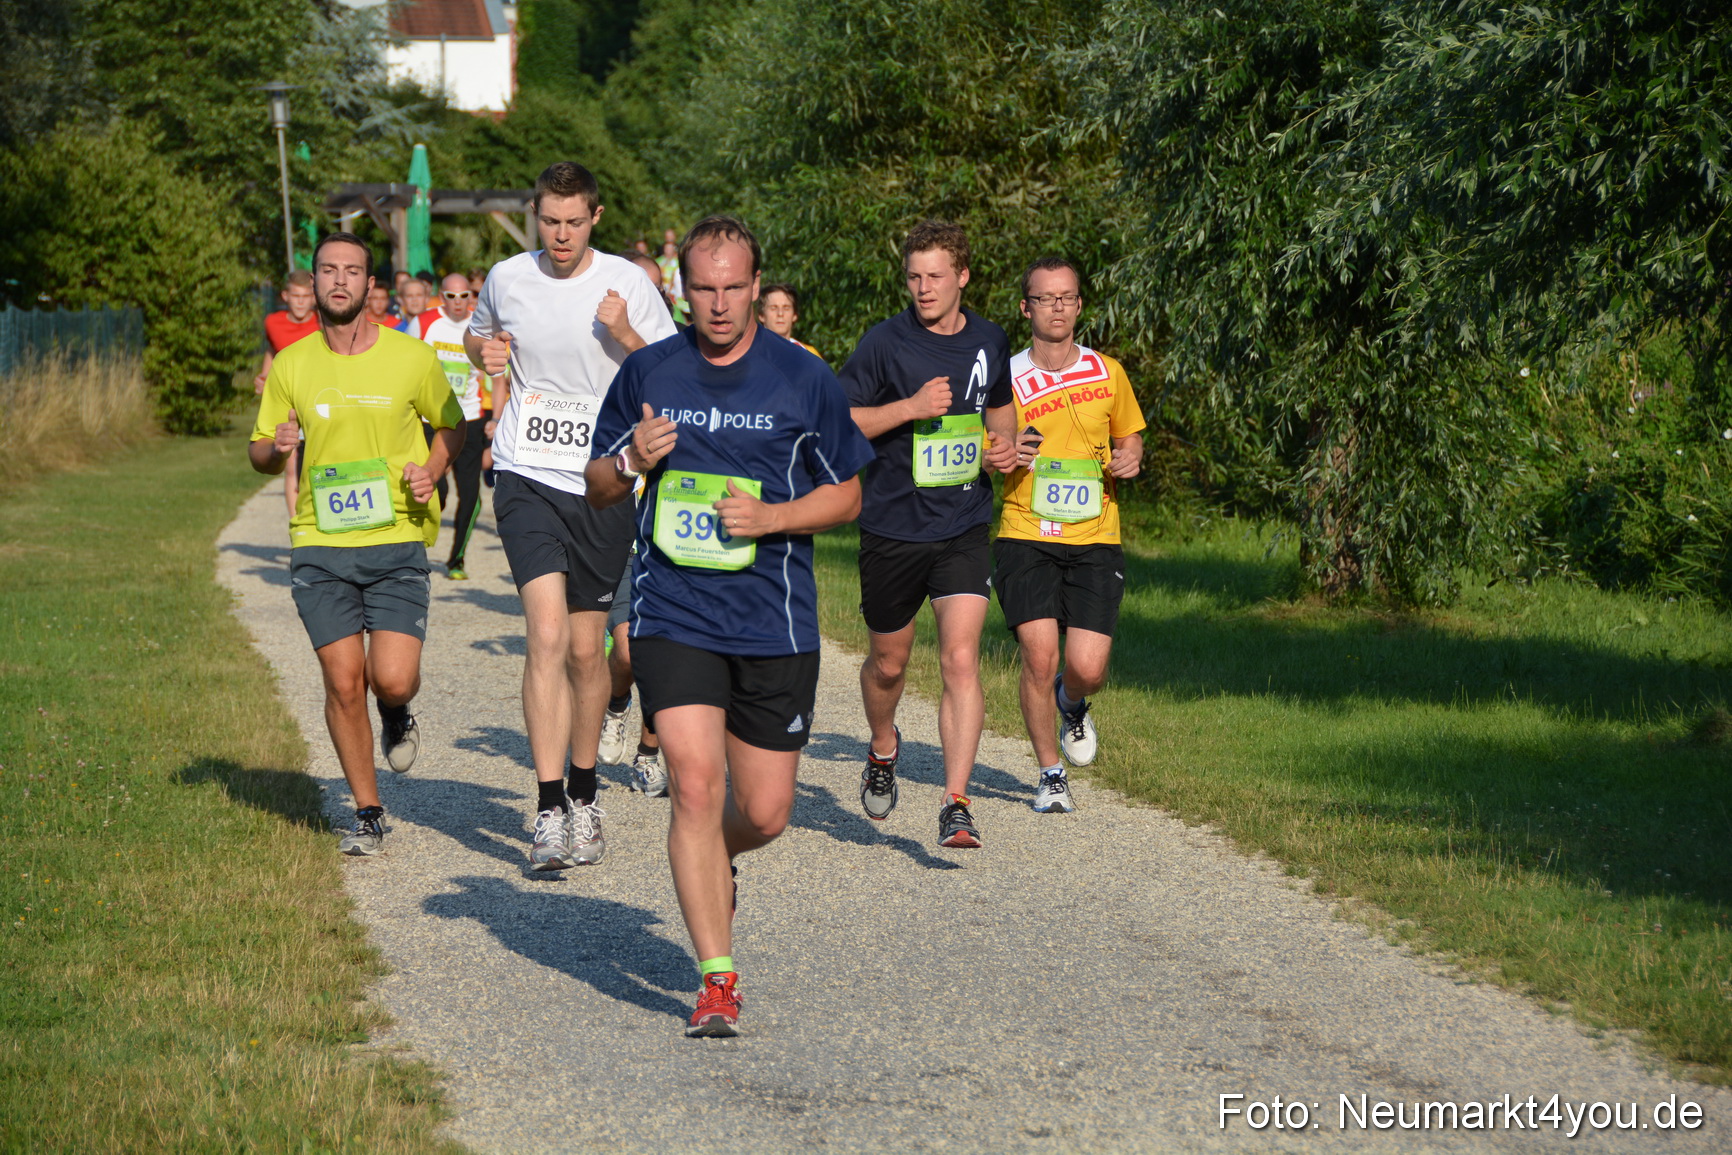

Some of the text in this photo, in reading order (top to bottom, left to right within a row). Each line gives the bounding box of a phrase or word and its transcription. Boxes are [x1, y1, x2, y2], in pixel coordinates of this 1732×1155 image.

[524, 393, 589, 411] df-sports
[1024, 386, 1113, 423] MAX BÖGL
[661, 408, 773, 430] EURO POLES
[526, 416, 590, 448] 8933
[922, 442, 977, 467] 1139
[328, 487, 374, 514] 641
[1046, 483, 1090, 506] 870
[675, 544, 730, 556] Marcus Feuerstein
